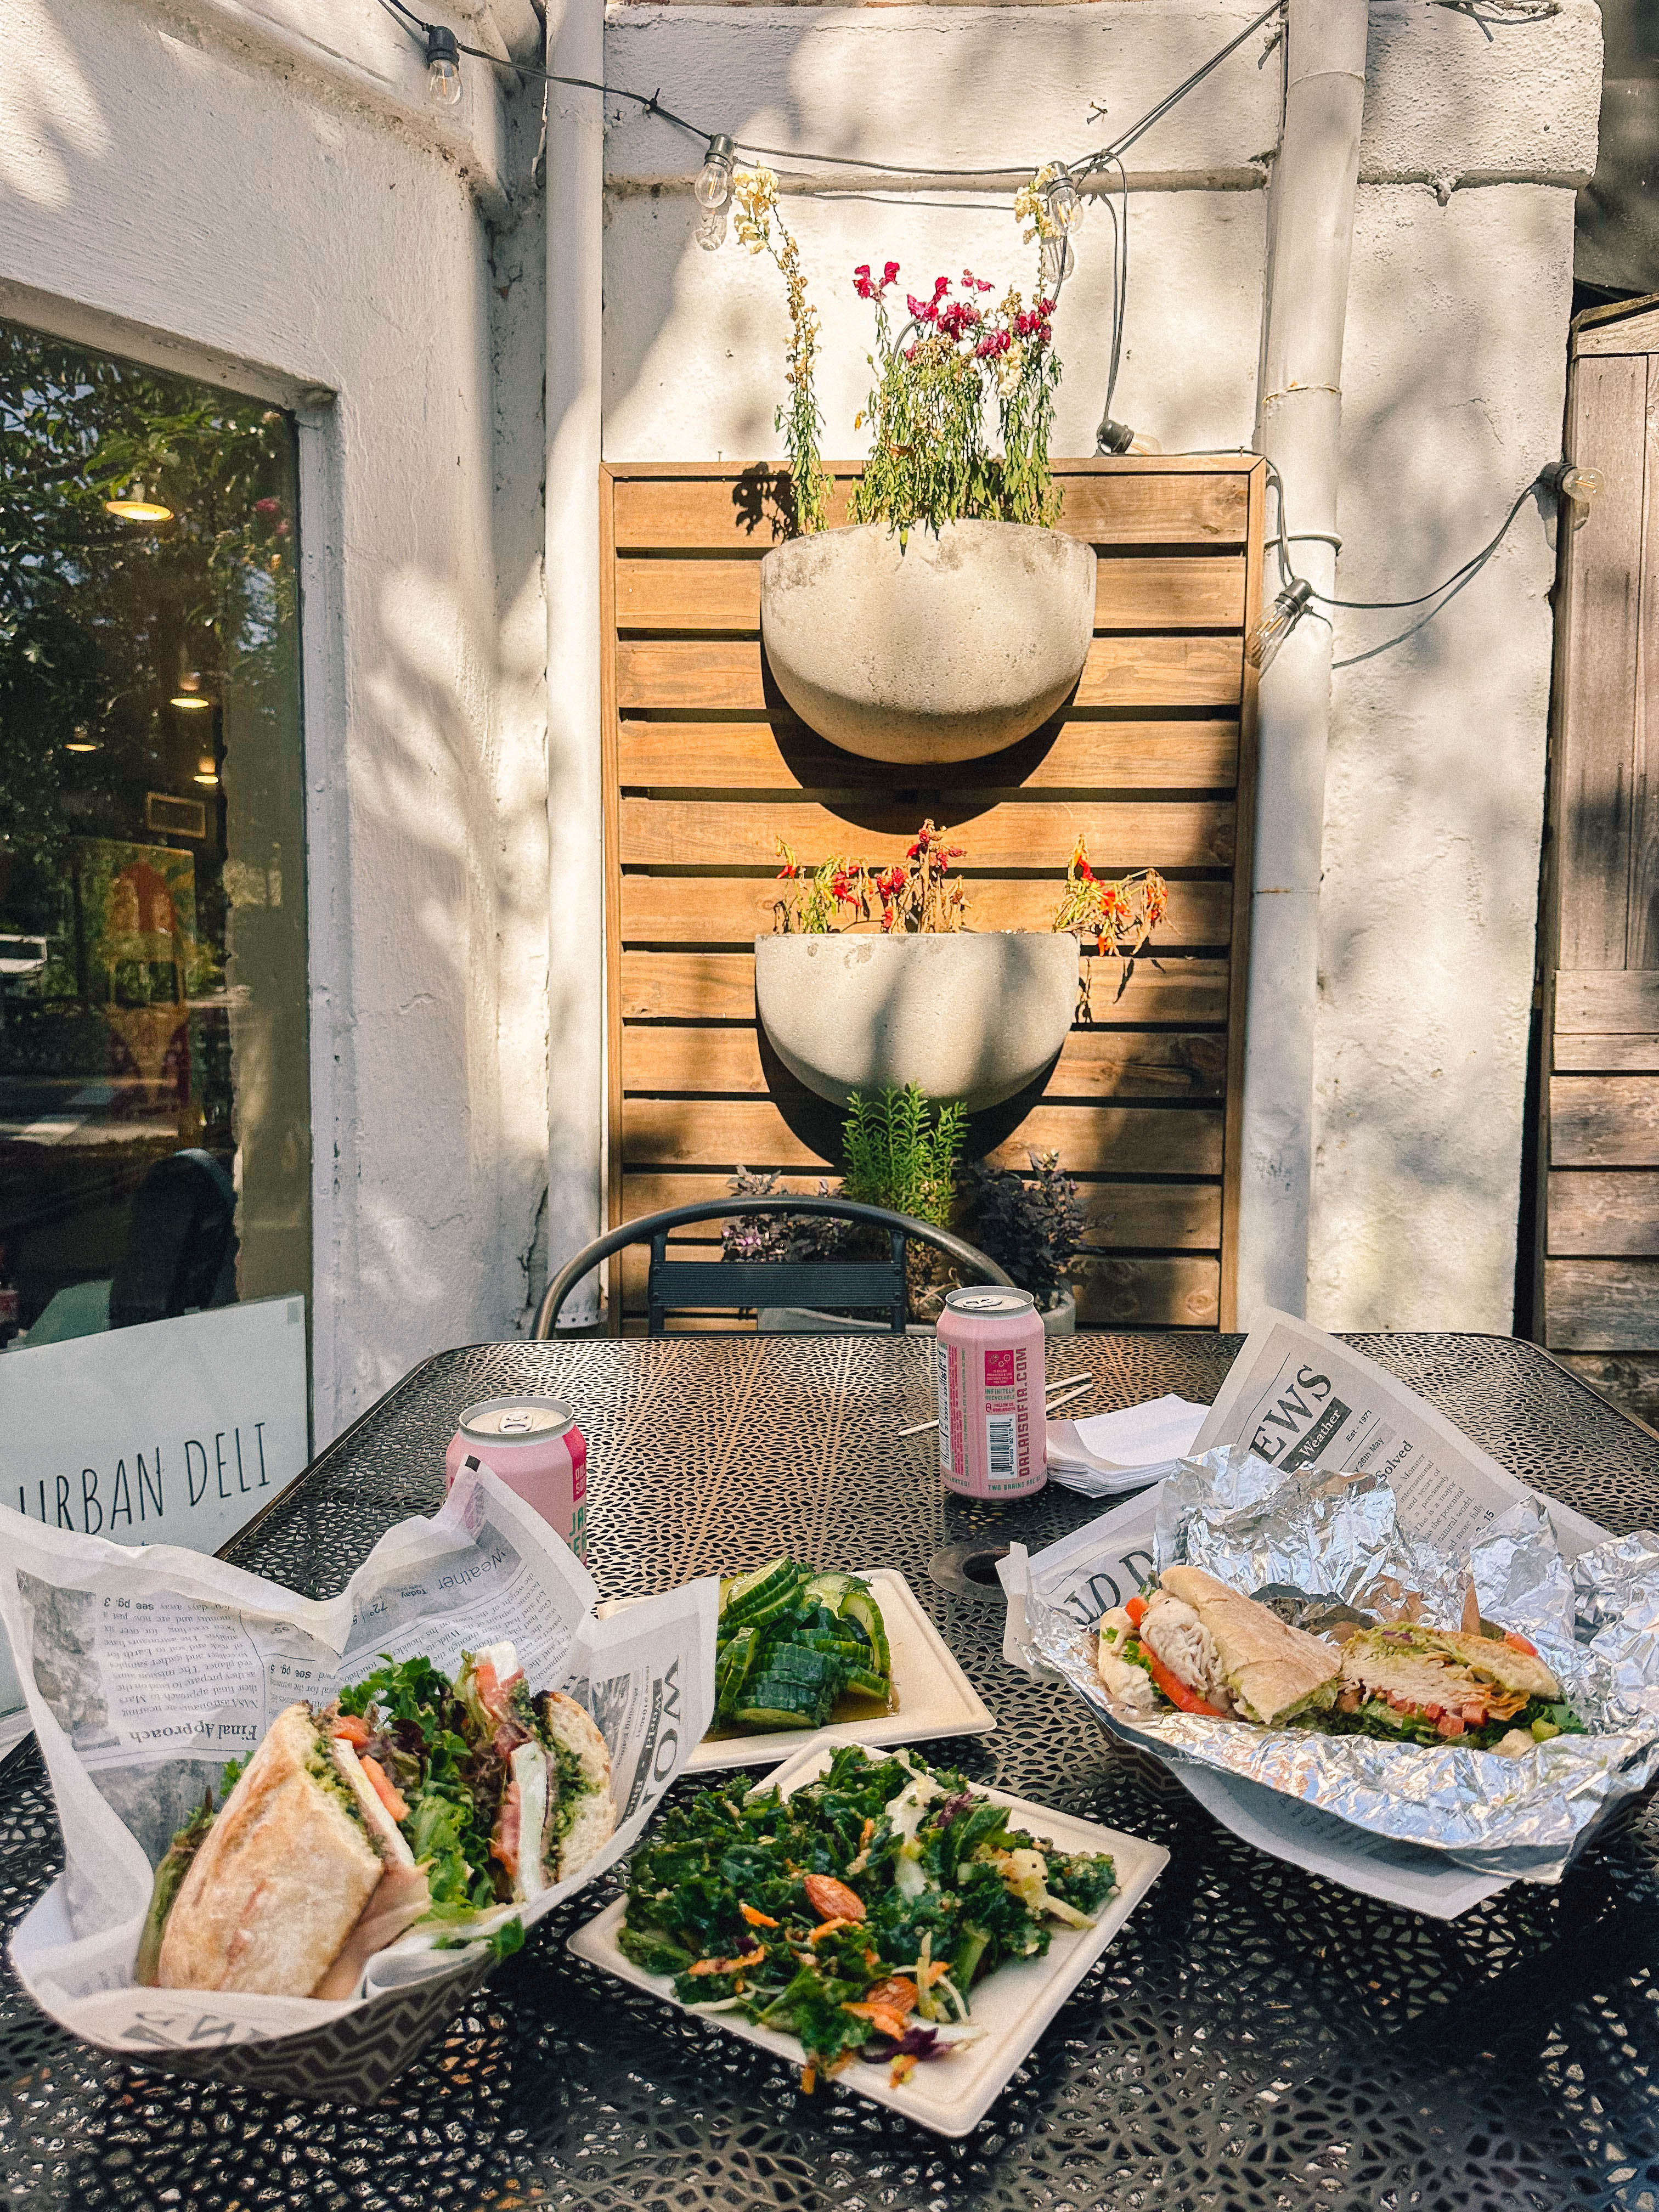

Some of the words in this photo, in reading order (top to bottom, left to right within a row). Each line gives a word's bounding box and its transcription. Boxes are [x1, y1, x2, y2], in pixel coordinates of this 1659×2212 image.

[1249, 1364, 1331, 1464] EWS
[1346, 1428, 1357, 1442] Est
[1358, 1409, 1373, 1425] 1971
[1298, 1409, 1341, 1457] Weather
[1357, 1452, 1372, 1468] 26th
[1369, 1436, 1385, 1453] May
[1375, 1440, 1414, 1481] Solved
[1400, 1453, 1426, 1481] Monster
[18, 1447, 163, 1535] URBAN
[184, 1423, 270, 1506] DELI
[1406, 1498, 1418, 1511] and
[1418, 1480, 1434, 1497] years
[1434, 1466, 1441, 1477] of
[1421, 1474, 1449, 1509] previously
[1439, 1481, 1457, 1505] major
[1430, 1516, 1443, 1530] the
[1441, 1487, 1466, 1519] potential
[1483, 1510, 1495, 1522] 15
[1437, 1517, 1458, 1543] natural
[1447, 1539, 1458, 1552] nd
[1456, 1521, 1472, 1540] more
[1470, 1503, 1486, 1522] fully
[439, 1547, 506, 1590] Weather
[104, 1598, 111, 1607] 3
[115, 1598, 131, 1610] pg.
[136, 1602, 154, 1611] see
[400, 1588, 428, 1598] Today
[1064, 1573, 1121, 1626] LD
[352, 1615, 358, 1625] 5
[426, 1627, 439, 1637] his
[128, 1720, 215, 1743] Approach
[218, 1724, 258, 1741] Final
[645, 1692, 662, 1749] World
